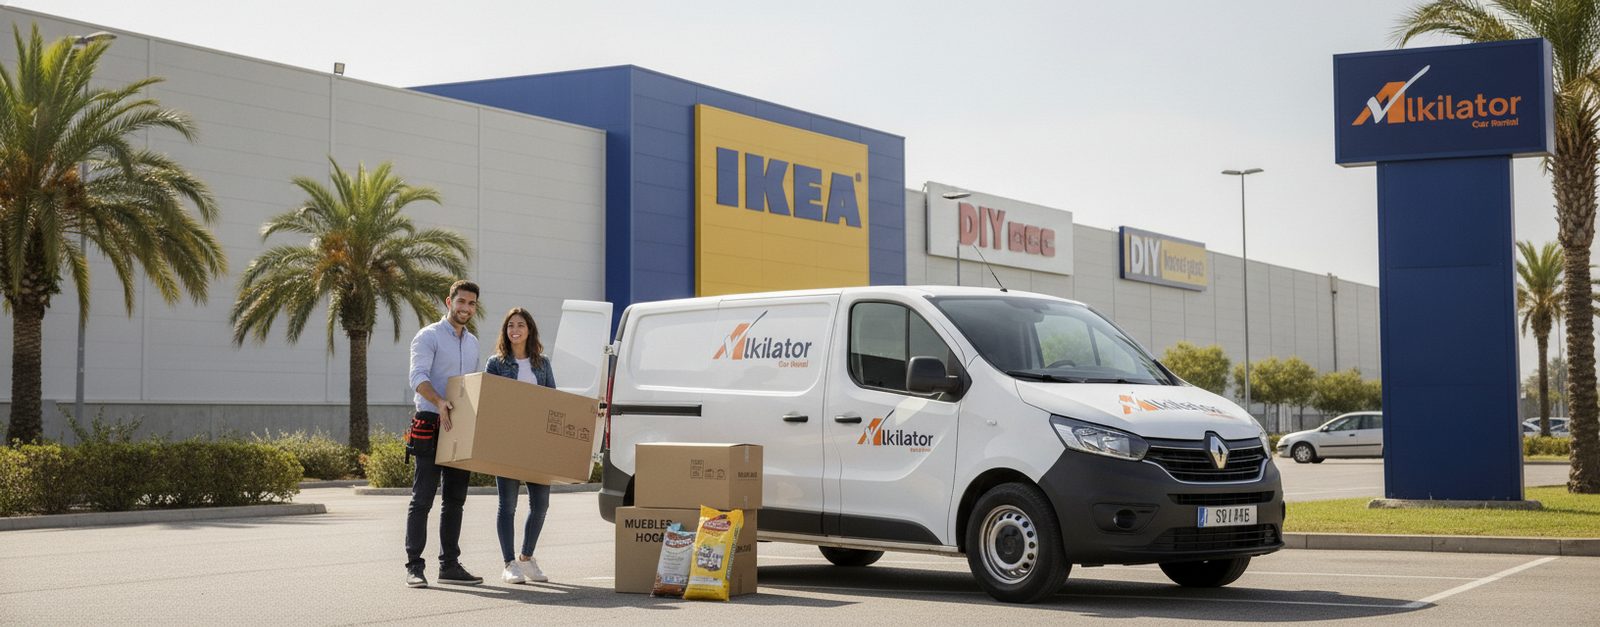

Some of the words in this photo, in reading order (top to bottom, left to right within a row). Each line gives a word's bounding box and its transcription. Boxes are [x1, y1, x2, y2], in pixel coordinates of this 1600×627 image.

[716, 147, 862, 228] IKEA
[959, 202, 1006, 250] DIY
[1131, 235, 1160, 276] DIY
